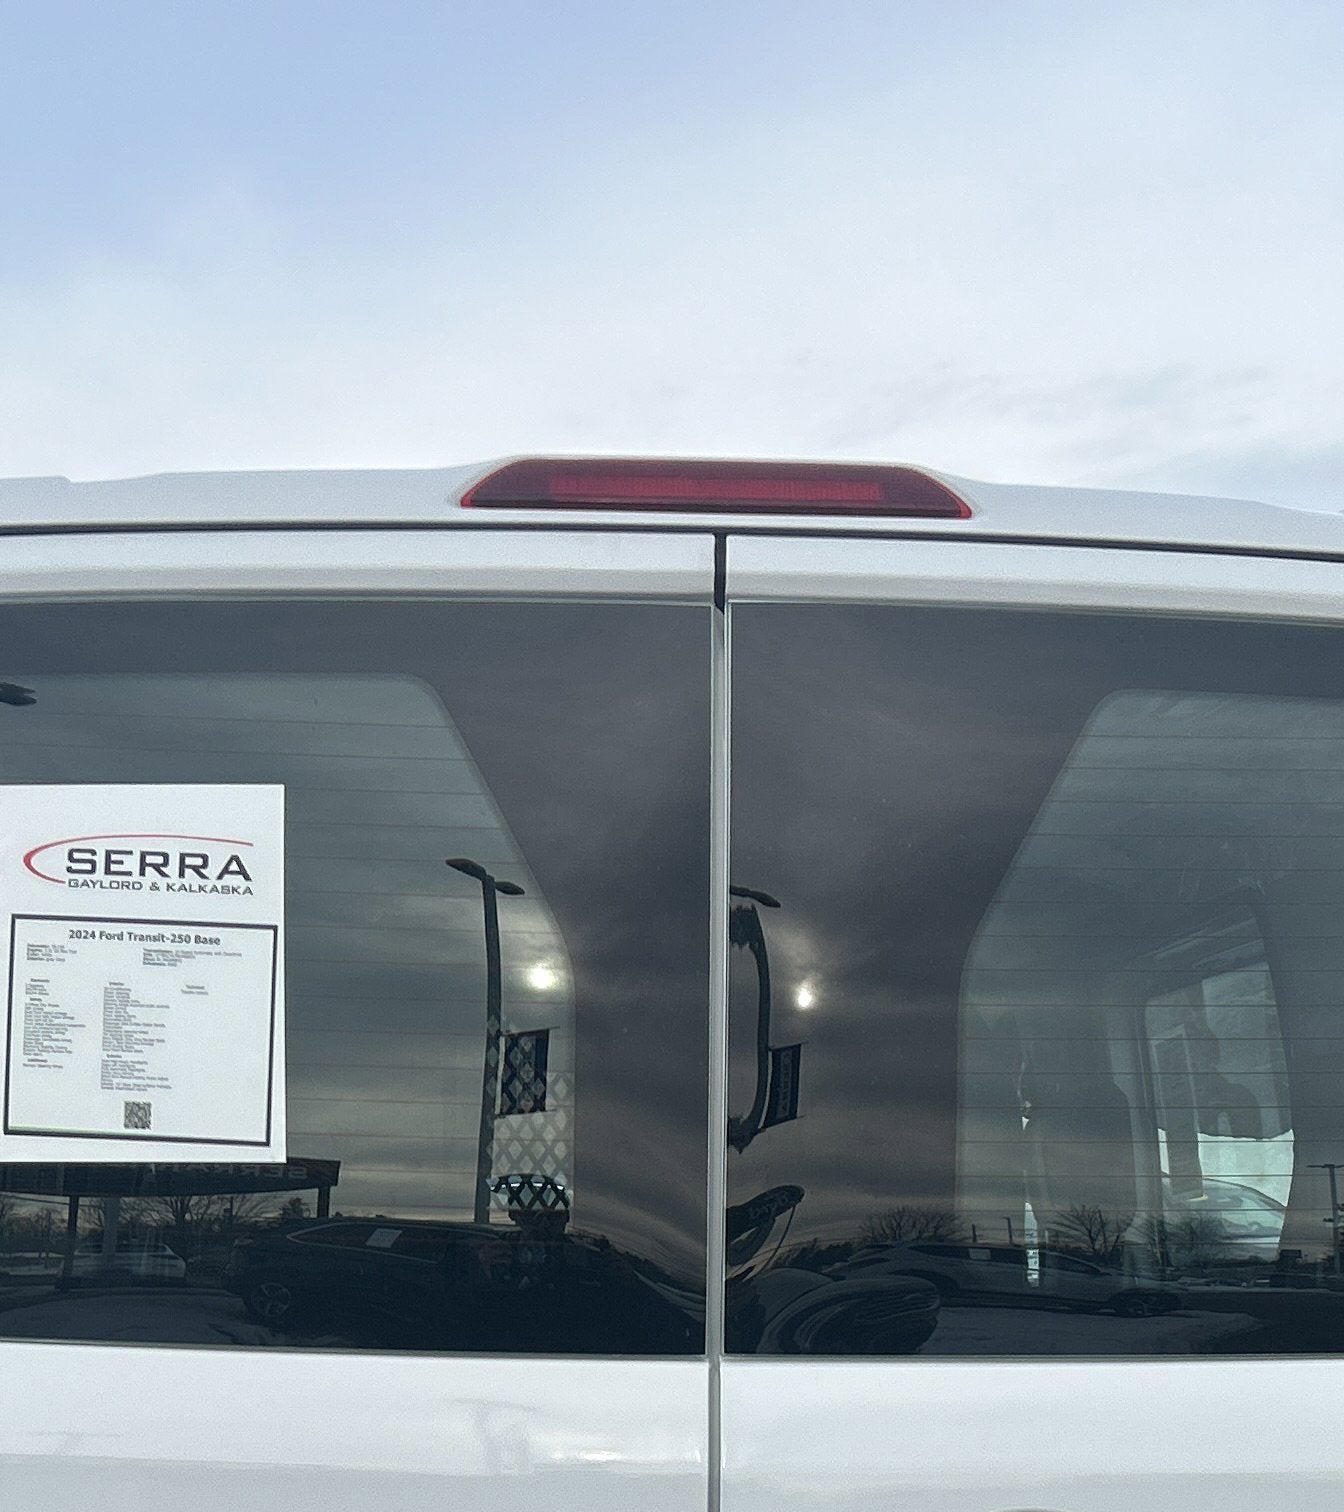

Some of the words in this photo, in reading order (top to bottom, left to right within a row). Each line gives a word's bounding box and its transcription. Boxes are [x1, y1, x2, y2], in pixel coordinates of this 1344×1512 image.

[65, 848, 254, 882] SERRA
[68, 878, 143, 892] GAYLORD
[149, 881, 161, 893] &
[166, 882, 254, 897] KALKASKA
[68, 929, 97, 941] 2024
[99, 930, 125, 943] Ford
[126, 931, 192, 945] Transit-250
[193, 934, 221, 947] Base
